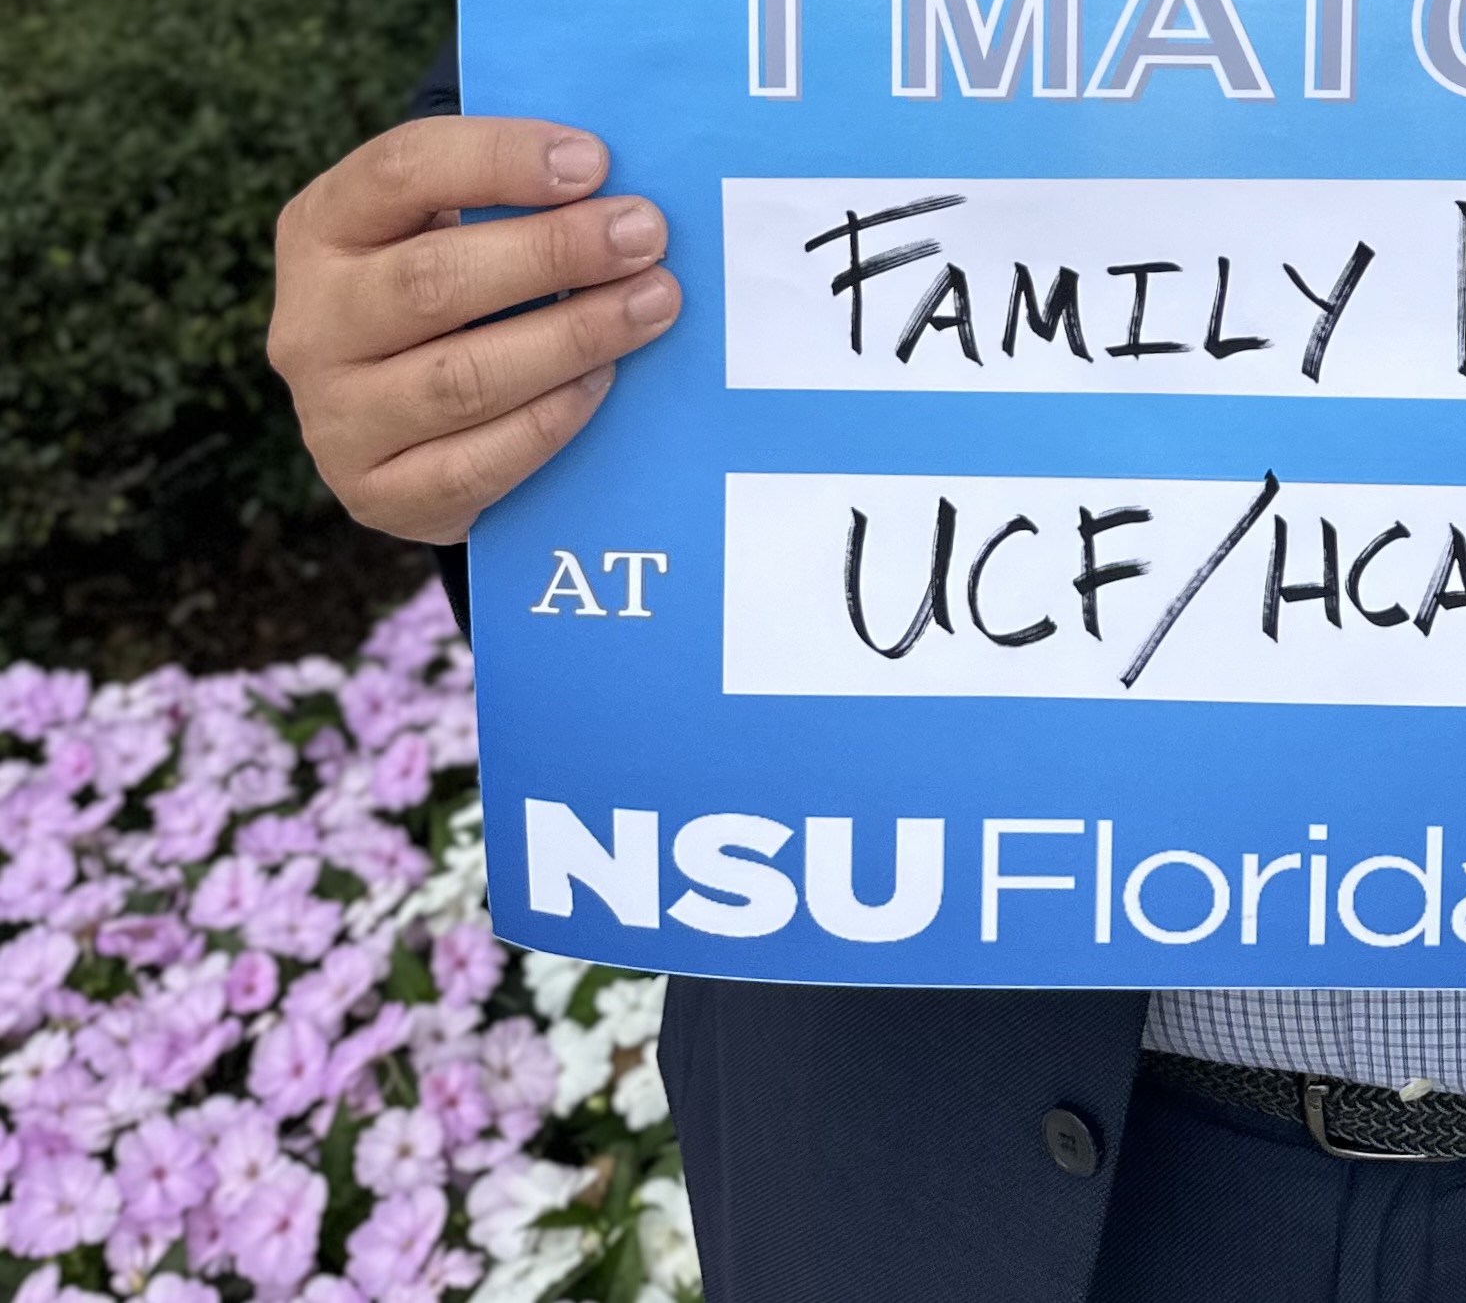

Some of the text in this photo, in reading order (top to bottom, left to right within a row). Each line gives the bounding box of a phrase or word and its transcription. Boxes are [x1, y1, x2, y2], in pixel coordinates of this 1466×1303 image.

[804, 193, 1375, 383] FAMILY
[530, 549, 669, 619] AT
[524, 797, 946, 943] NSU
